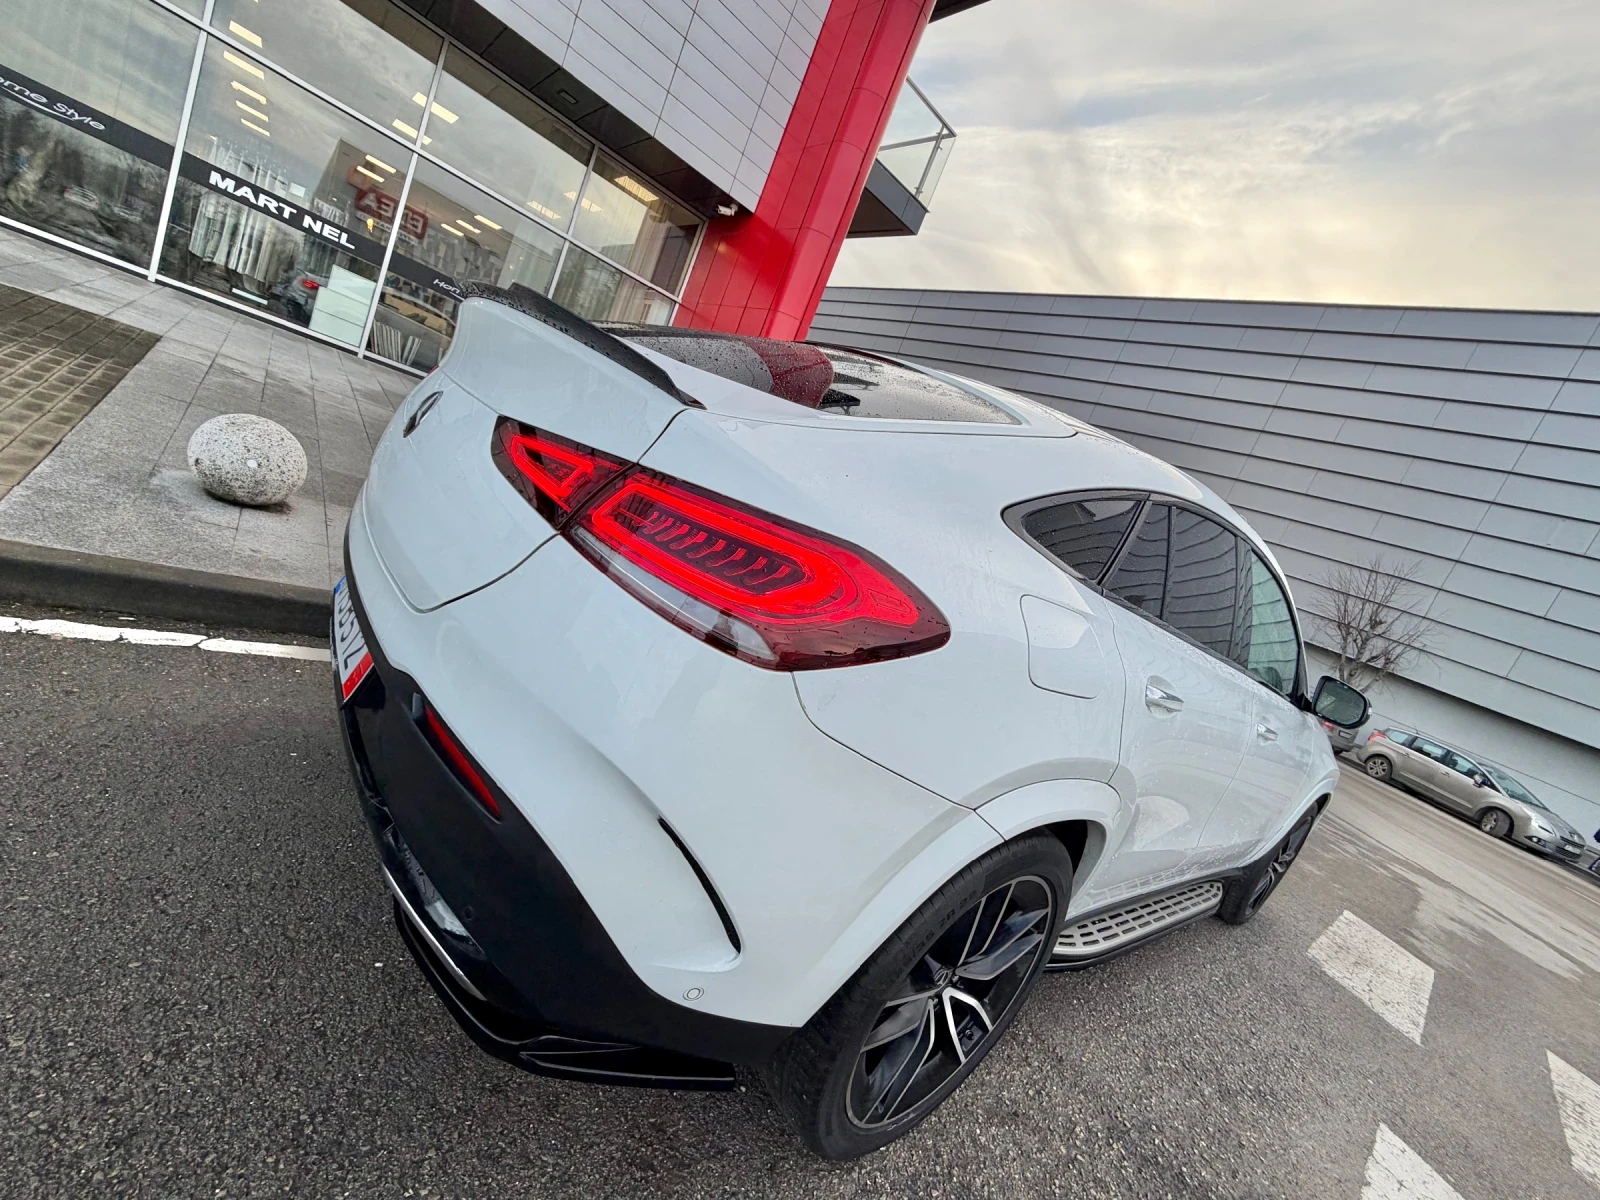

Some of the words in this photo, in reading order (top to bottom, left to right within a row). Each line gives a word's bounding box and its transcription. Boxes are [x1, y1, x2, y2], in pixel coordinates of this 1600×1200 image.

[53, 103, 106, 130] Style
[209, 170, 297, 219] MART
[302, 214, 355, 250] NEL
